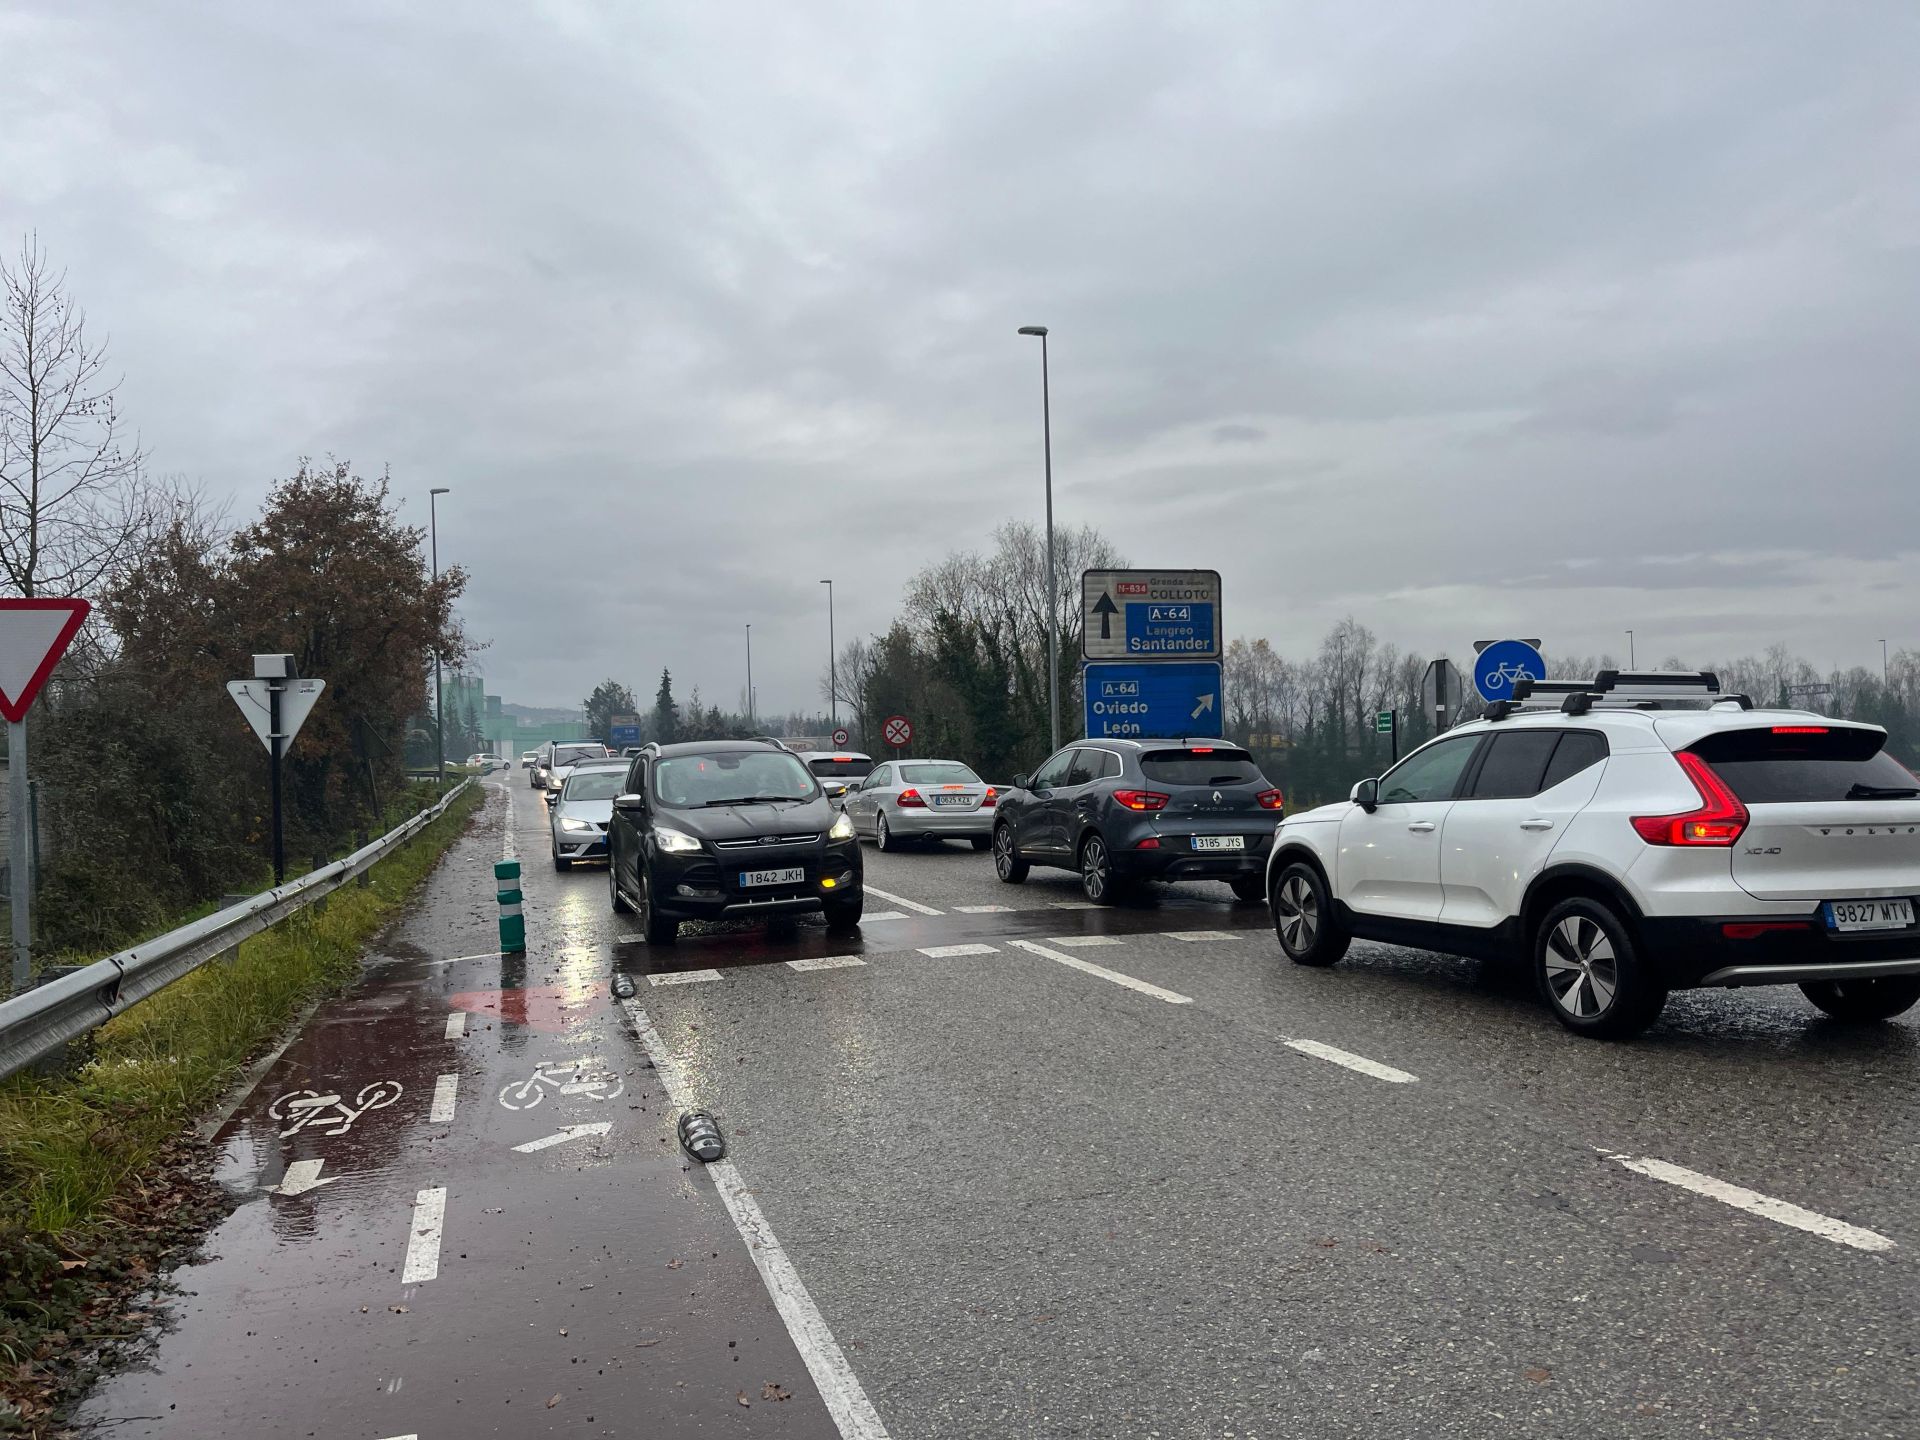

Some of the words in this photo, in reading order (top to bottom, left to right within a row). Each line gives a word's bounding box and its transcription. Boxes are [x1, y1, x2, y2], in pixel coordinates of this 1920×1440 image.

[1118, 584, 1147, 593] N-634
[1150, 589, 1210, 600] COLLOTO
[1151, 607, 1188, 619] A-64
[1146, 626, 1194, 637] Langreo
[1130, 637, 1210, 650] Santander
[1104, 683, 1137, 695] A-64
[1093, 701, 1149, 714] Oviedo
[1103, 720, 1140, 734] León
[1820, 826, 1916, 836] VOLVO
[1225, 838, 1241, 848] JYS
[750, 872, 778, 884] 1842
[781, 869, 803, 881] JKH
[1836, 904, 1875, 922] 9827
[1880, 902, 1908, 921] MTV
